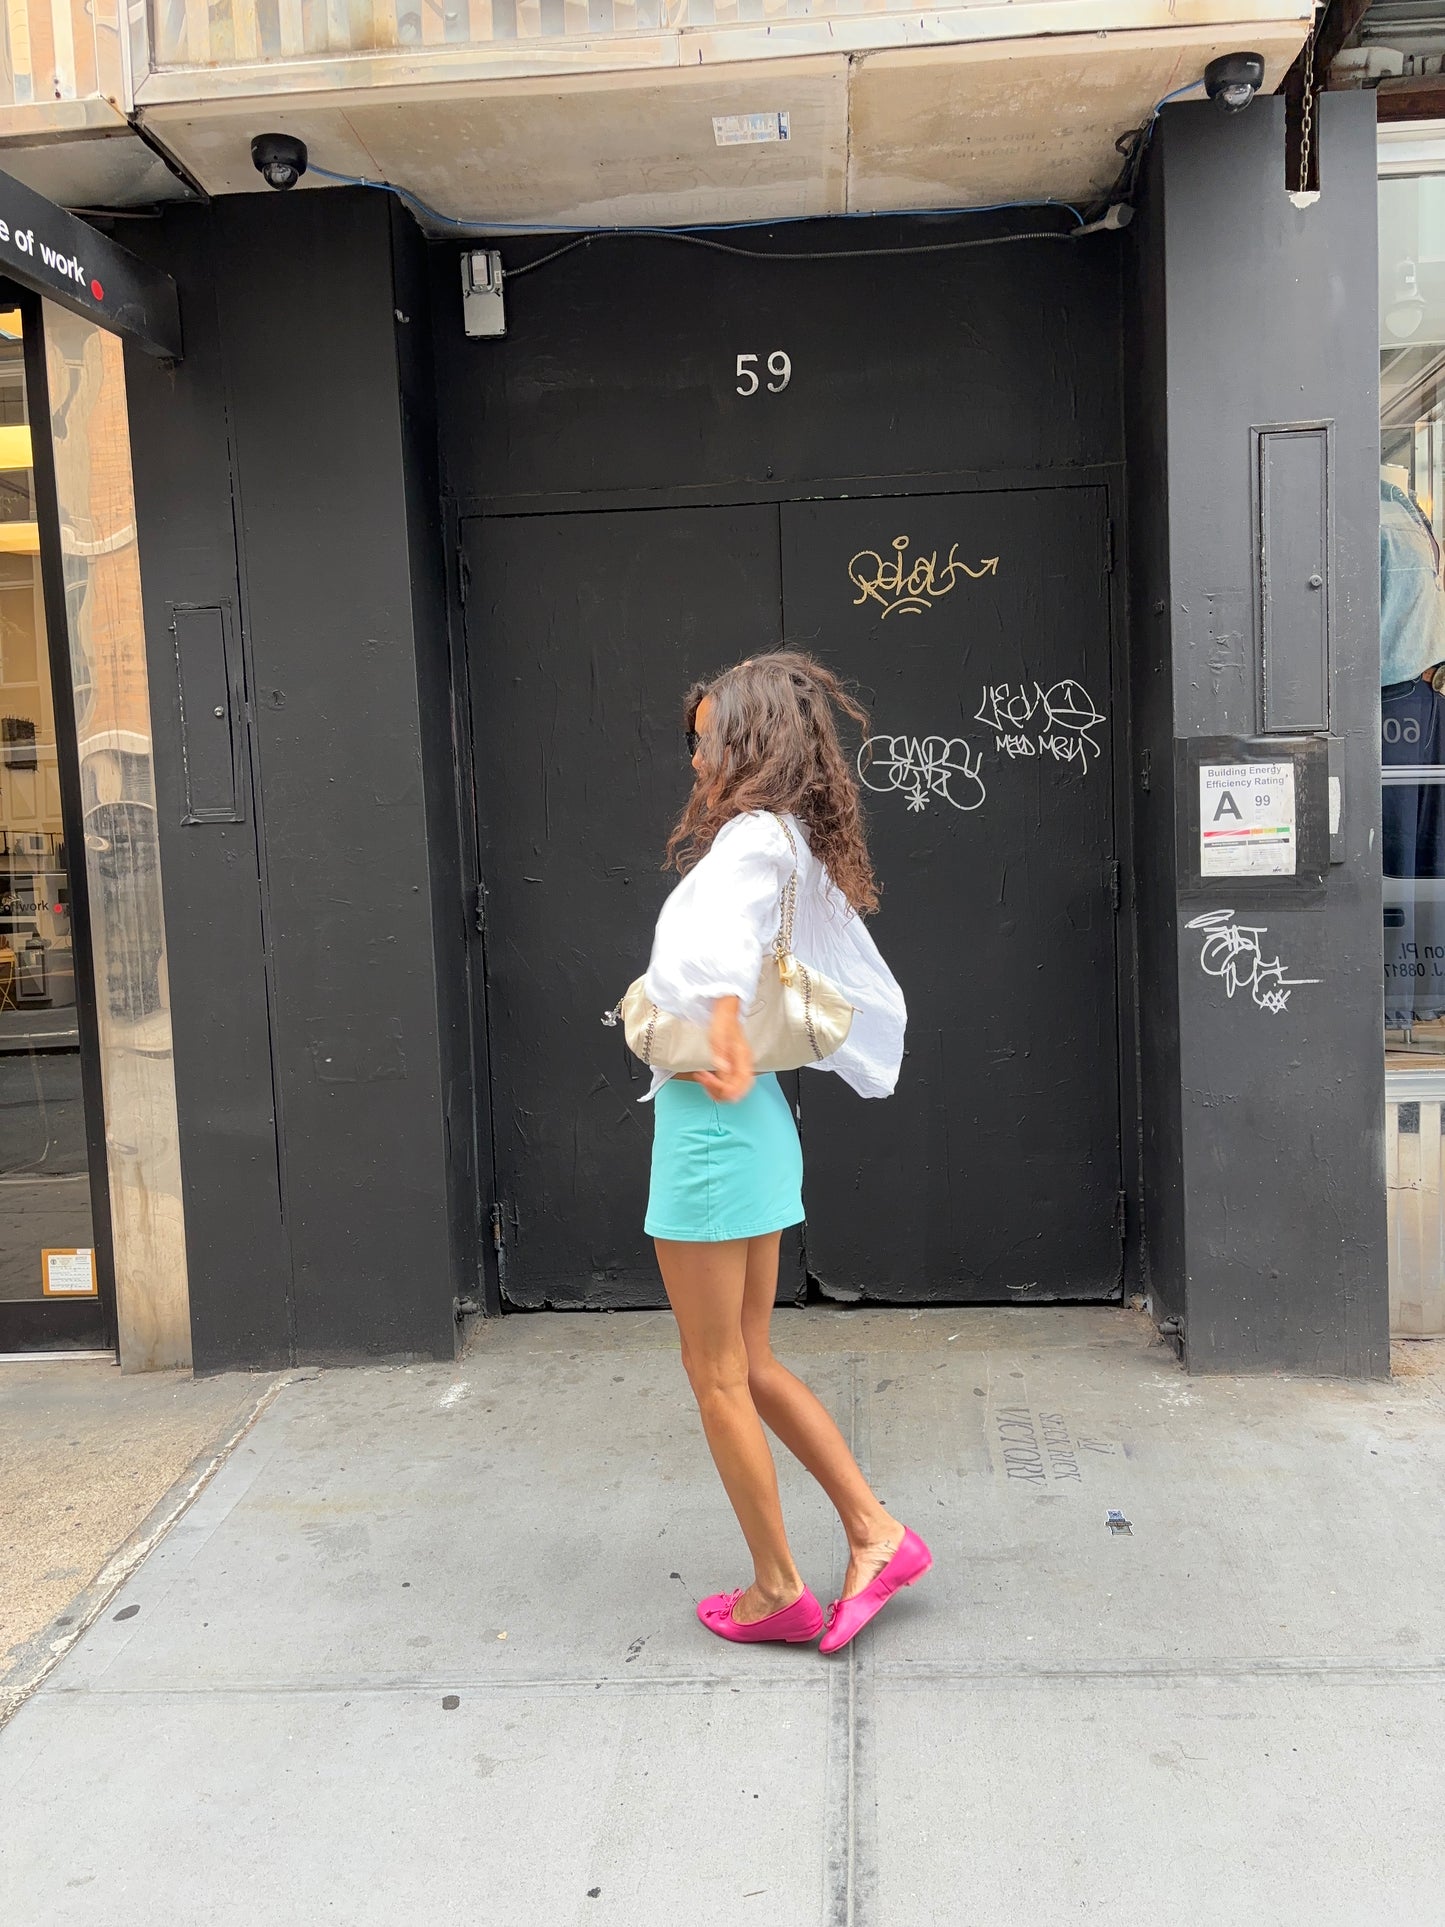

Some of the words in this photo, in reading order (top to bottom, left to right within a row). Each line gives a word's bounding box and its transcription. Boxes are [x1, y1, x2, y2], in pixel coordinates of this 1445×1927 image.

[14, 229, 35, 256] of
[39, 242, 87, 287] work
[736, 350, 792, 396] 59
[1206, 779, 1252, 789] Efficiency
[1254, 777, 1285, 786] Rating
[1207, 768, 1247, 777] Building
[1249, 766, 1282, 775] Energy
[1213, 790, 1243, 821] A
[1255, 794, 1271, 807] 99
[20, 900, 49, 912] work
[994, 1408, 1048, 1487] VICTORY
[1048, 1449, 1083, 1483] RICK
